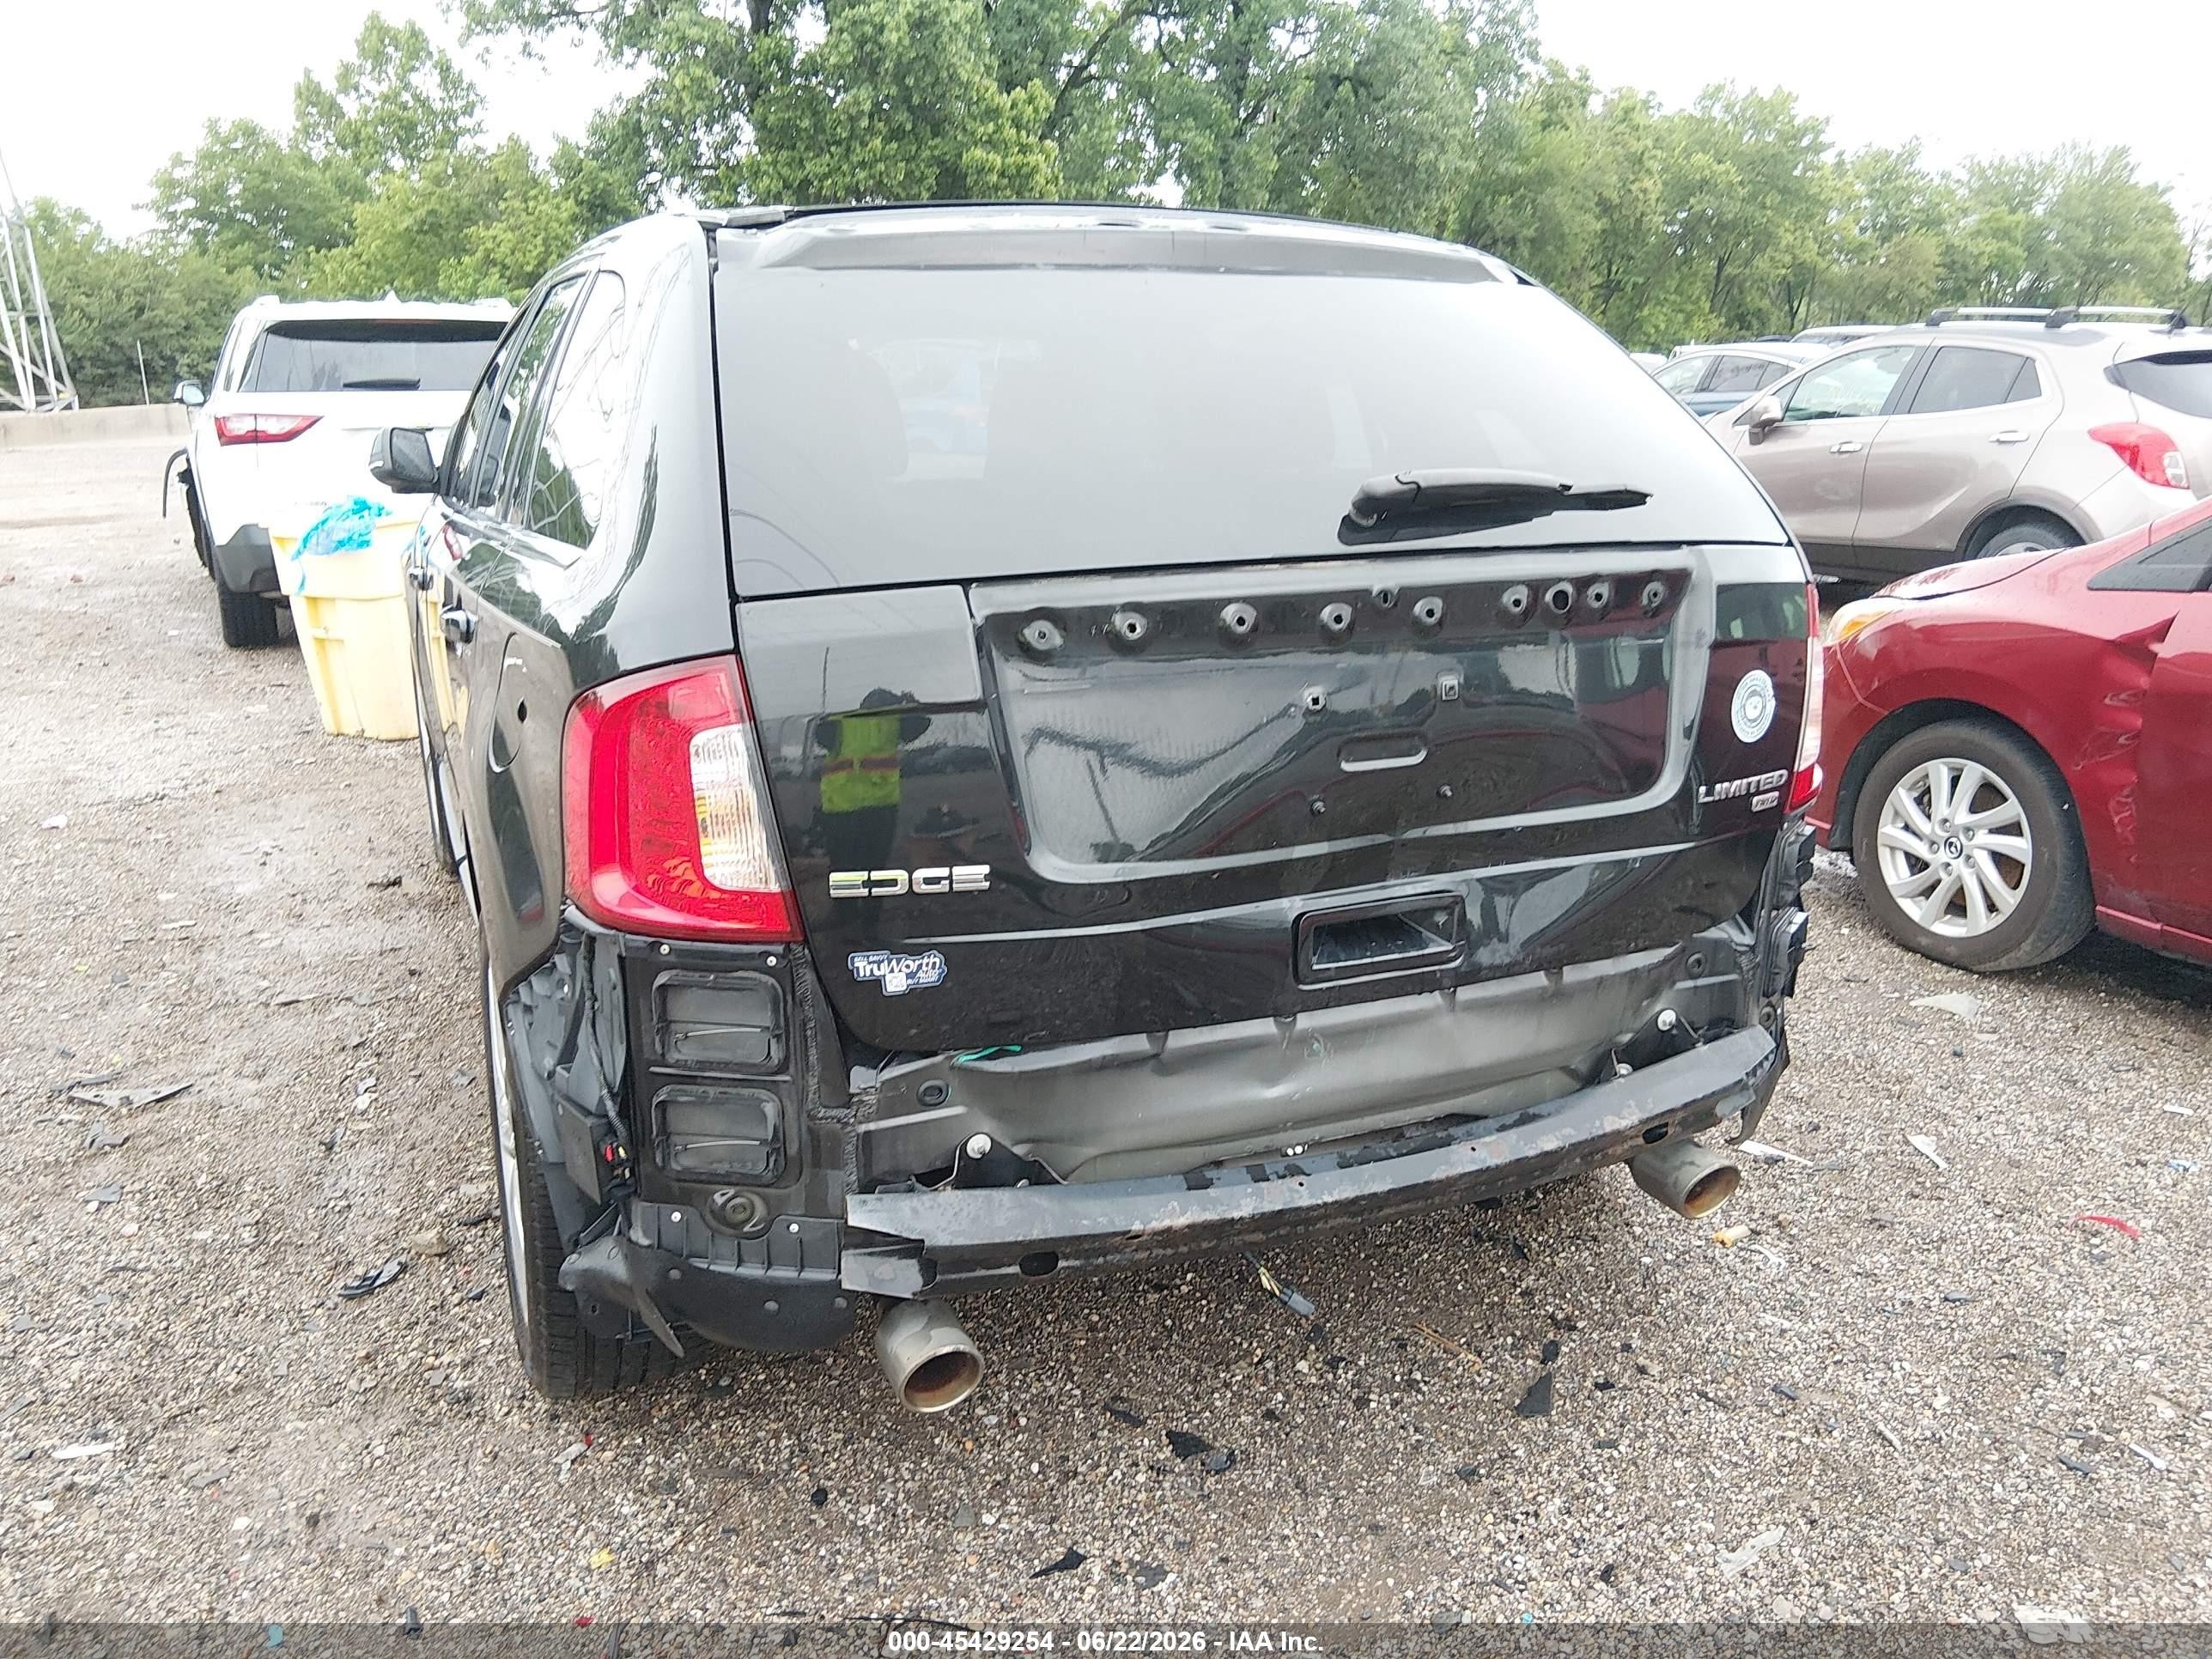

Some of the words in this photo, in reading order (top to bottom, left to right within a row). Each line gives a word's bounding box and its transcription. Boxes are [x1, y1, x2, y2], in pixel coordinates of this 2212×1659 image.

[1698, 769, 1789, 803] LIMITED
[829, 864, 991, 897] EDGE
[854, 954, 940, 977] TruWorth
